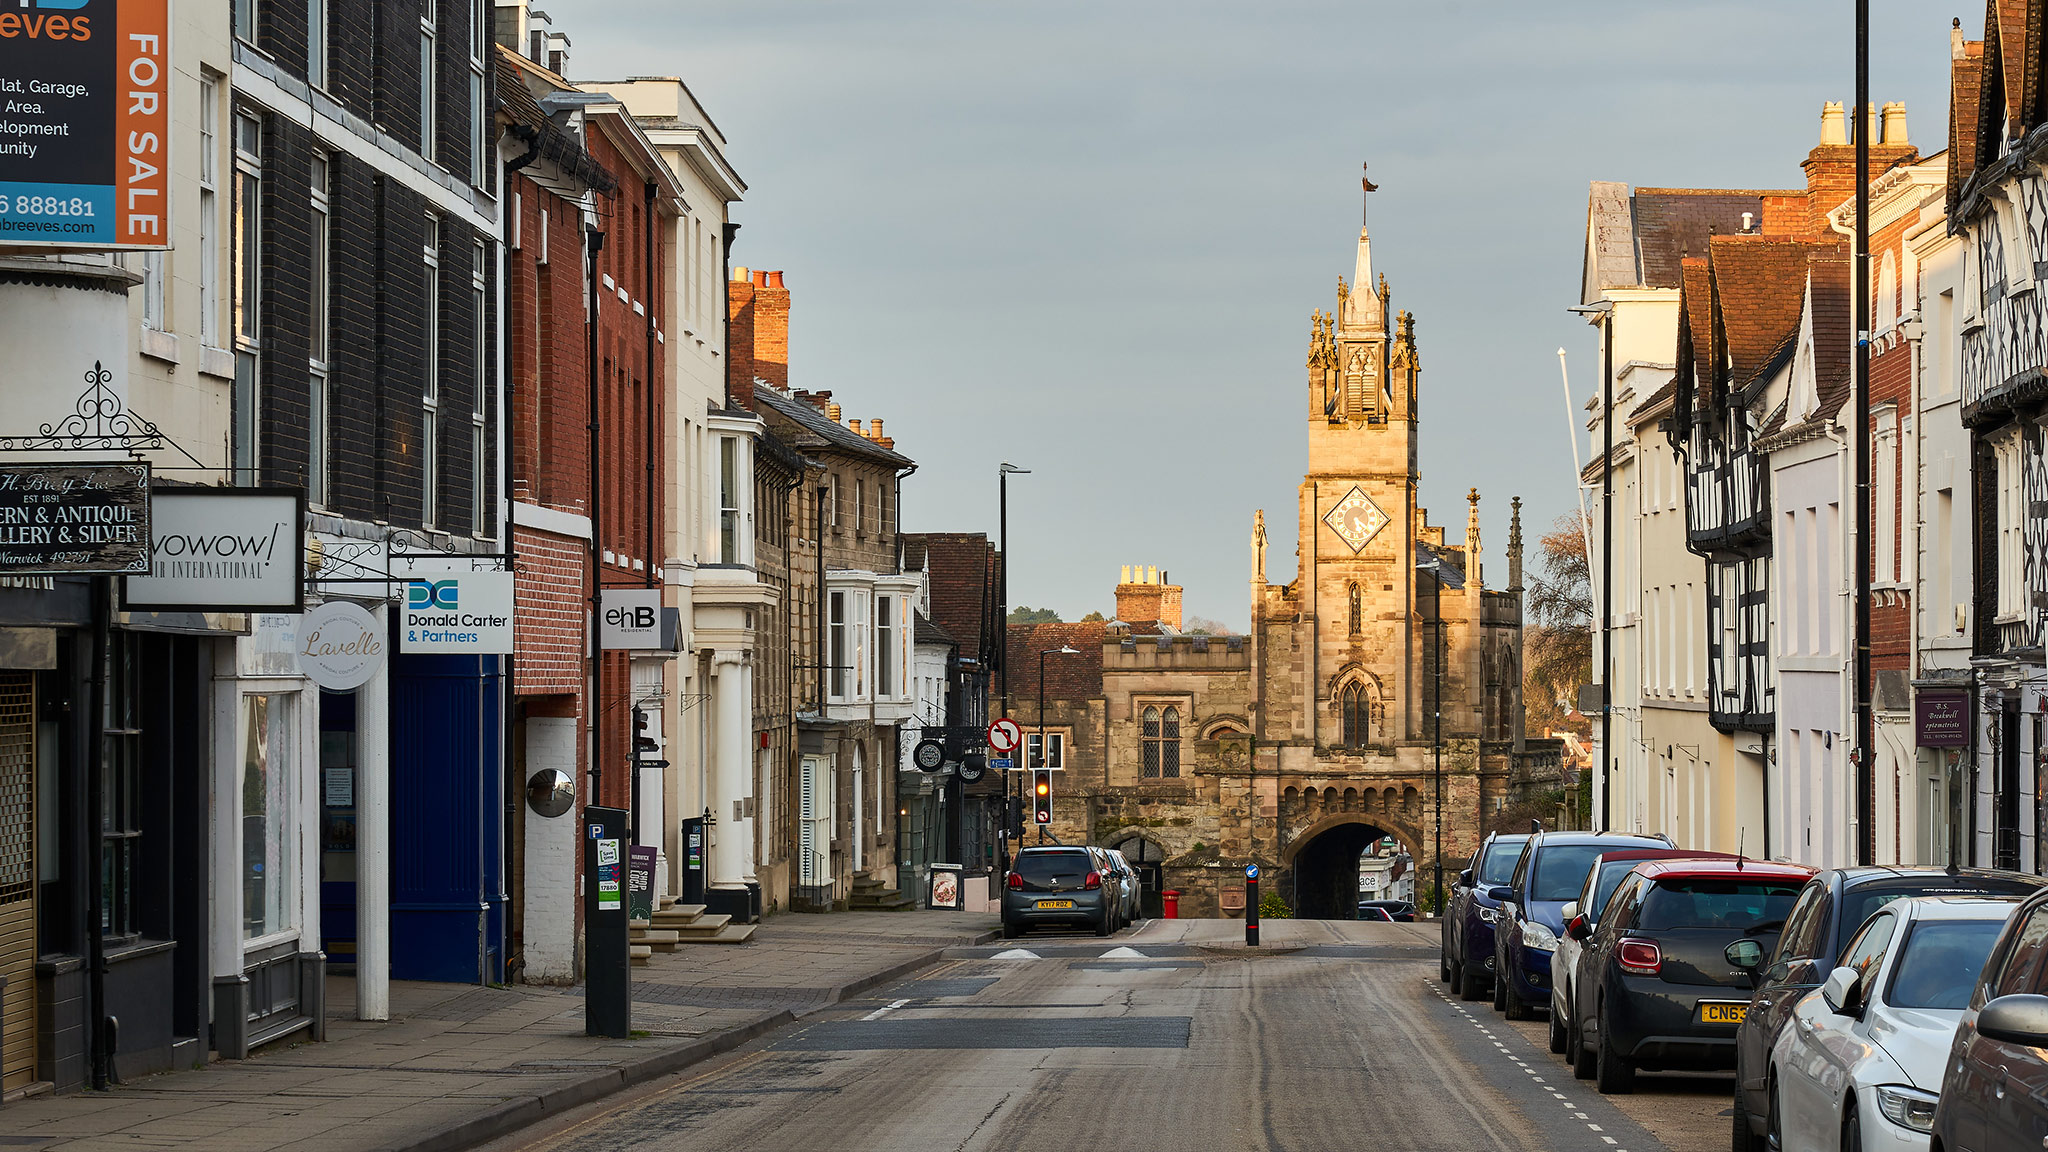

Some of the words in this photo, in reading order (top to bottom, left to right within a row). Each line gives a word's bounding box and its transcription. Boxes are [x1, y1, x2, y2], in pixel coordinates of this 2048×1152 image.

[0, 12, 91, 41] eves
[129, 34, 158, 115] FOR
[0, 78, 25, 94] lat,
[29, 79, 89, 98] Garage,
[5, 100, 45, 114] Area.
[129, 131, 158, 235] SALE
[16, 195, 95, 217] 888181
[0, 218, 95, 233] breeves.com
[24, 495, 38, 503] EST
[42, 495, 60, 503] 1891
[35, 506, 49, 524] &
[54, 505, 137, 524] ANTIQUE
[58, 526, 73, 544] &
[79, 525, 138, 543] SILVER
[172, 561, 262, 579] INTERNATIONAL
[322, 617, 339, 626] BRIDAL
[339, 616, 360, 626] COUTURE
[408, 613, 458, 627] Donald
[461, 613, 508, 627] Carter
[606, 606, 656, 628] ehB
[301, 631, 383, 657] Lavelle
[408, 630, 417, 642] &
[422, 630, 478, 642] Partners
[322, 664, 338, 675] BRIDAL
[338, 664, 360, 675] COUTURE
[592, 826, 602, 838] P
